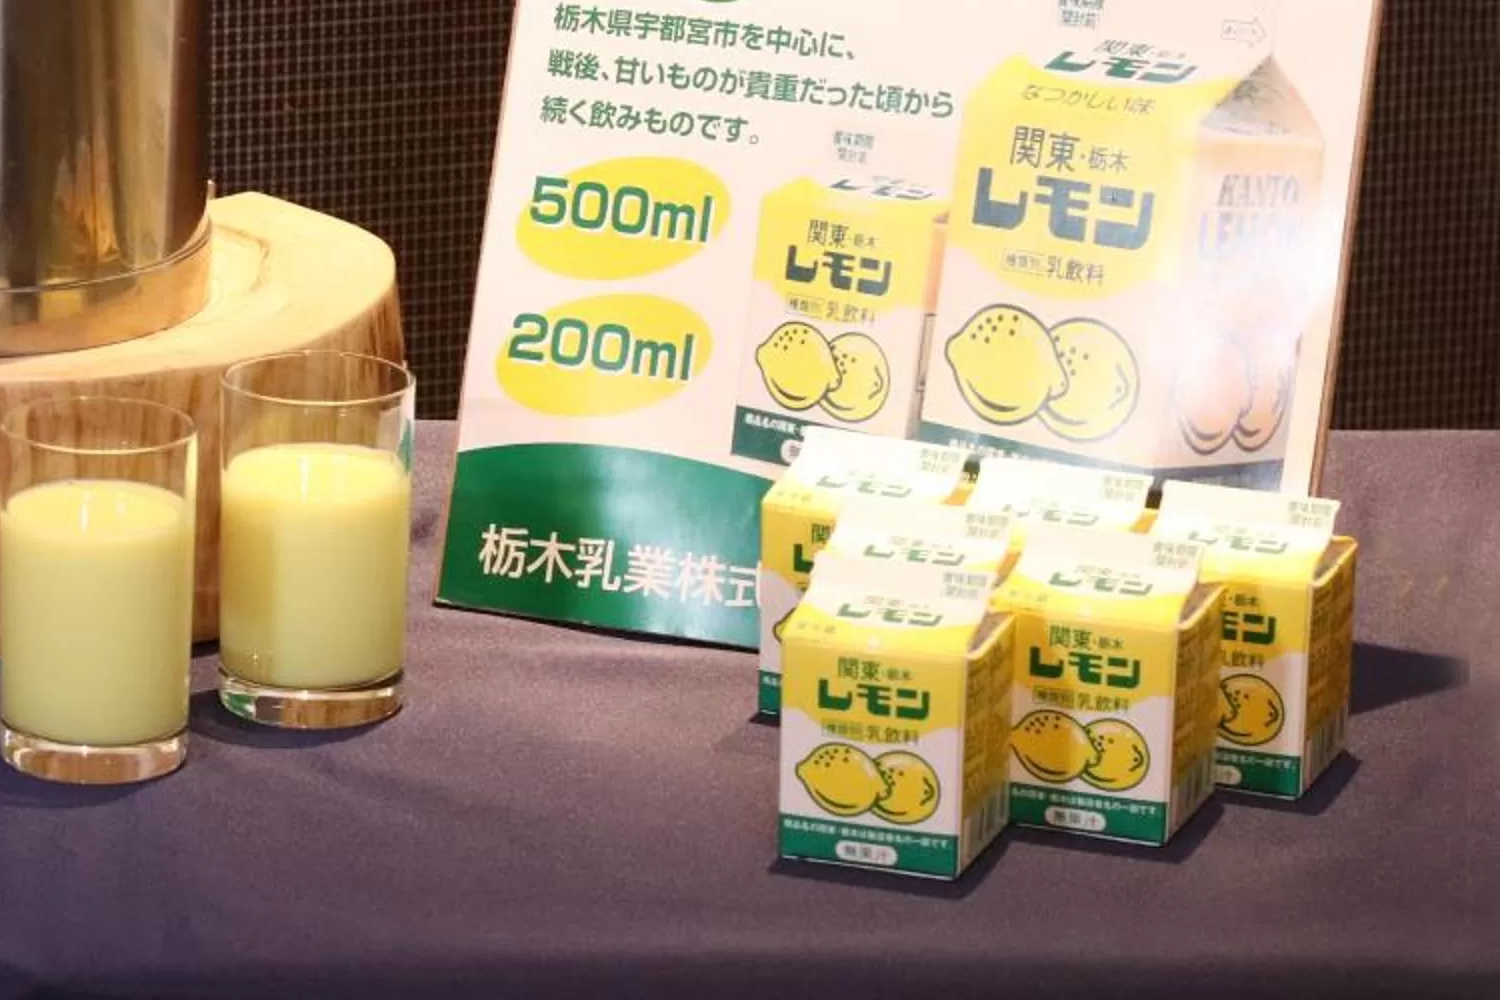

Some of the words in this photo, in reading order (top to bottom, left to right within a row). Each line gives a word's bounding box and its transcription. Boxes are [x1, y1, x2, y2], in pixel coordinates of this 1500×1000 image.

[553, 2, 855, 60] 栃木県宇都宮市を中心に、
[547, 49, 955, 118] 戦後、甘いものが貴重だった頃から
[1044, 51, 1198, 84] レモン
[541, 95, 760, 146] 続く飲みものです。
[1009, 125, 1130, 174] 関東・栃木
[529, 175, 713, 245] 500ml
[972, 166, 1156, 251] レモン
[785, 244, 893, 297] レモン
[507, 312, 695, 382] 200ml
[1049, 571, 1154, 597] レモン
[836, 603, 944, 628] レモン
[1029, 646, 1141, 690] レモン
[818, 678, 930, 722] レモン
